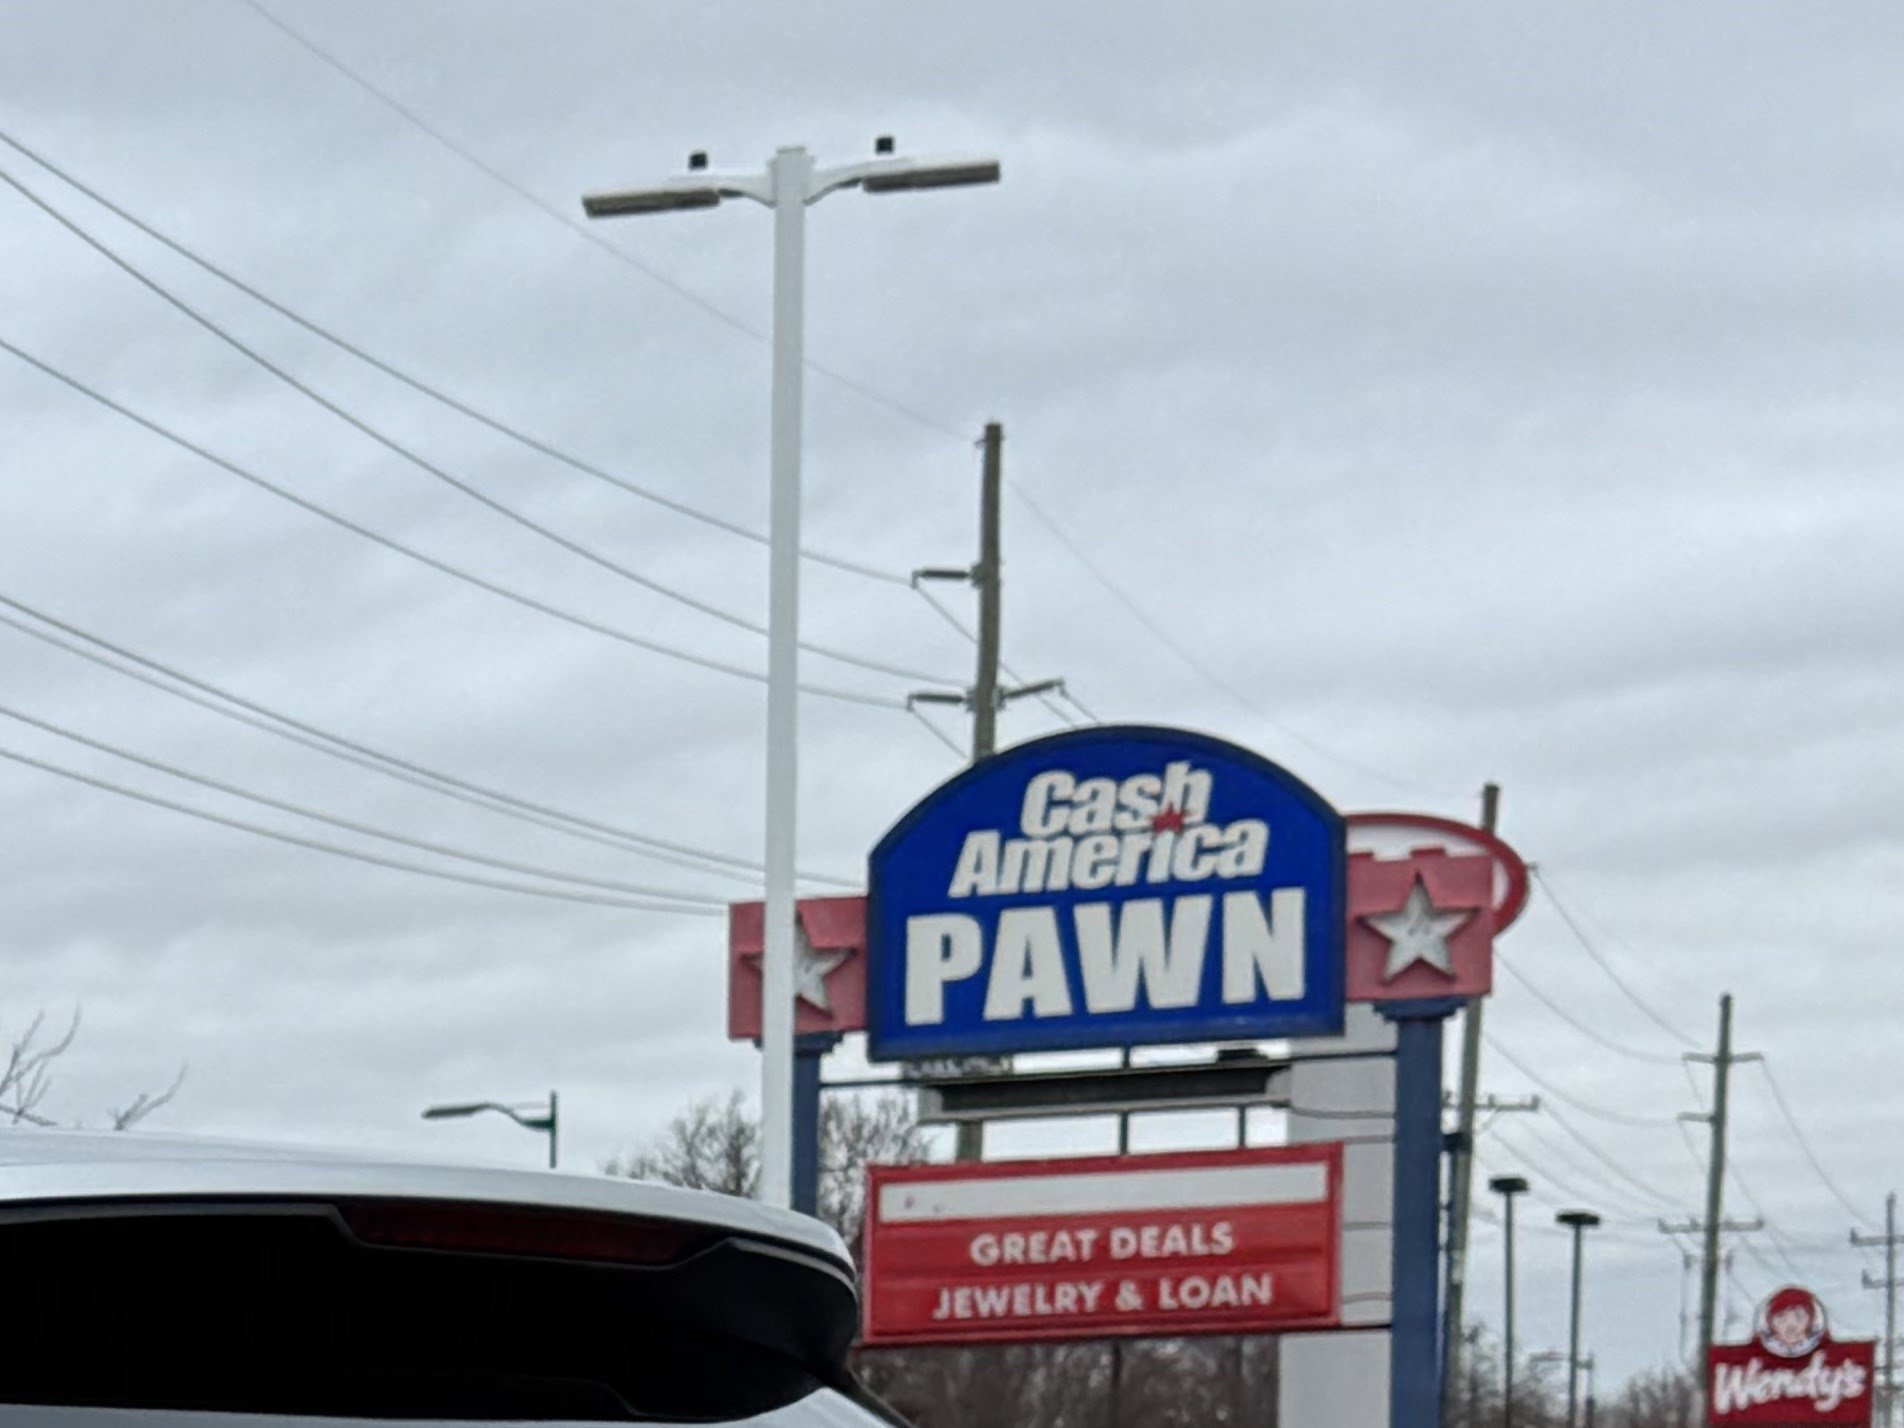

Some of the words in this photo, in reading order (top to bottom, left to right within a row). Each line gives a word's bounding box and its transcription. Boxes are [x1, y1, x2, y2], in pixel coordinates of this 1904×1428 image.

[1020, 760, 1213, 837] Cash
[947, 818, 1271, 898] America
[904, 886, 1305, 1026] PAWN
[970, 1228, 1100, 1266] GREAT
[1110, 1221, 1234, 1260] DEALS
[933, 1281, 1103, 1320] JEWELRY
[1114, 1280, 1143, 1311] &
[1158, 1273, 1274, 1309] LOAN
[1714, 1351, 1867, 1415] Wendy's
